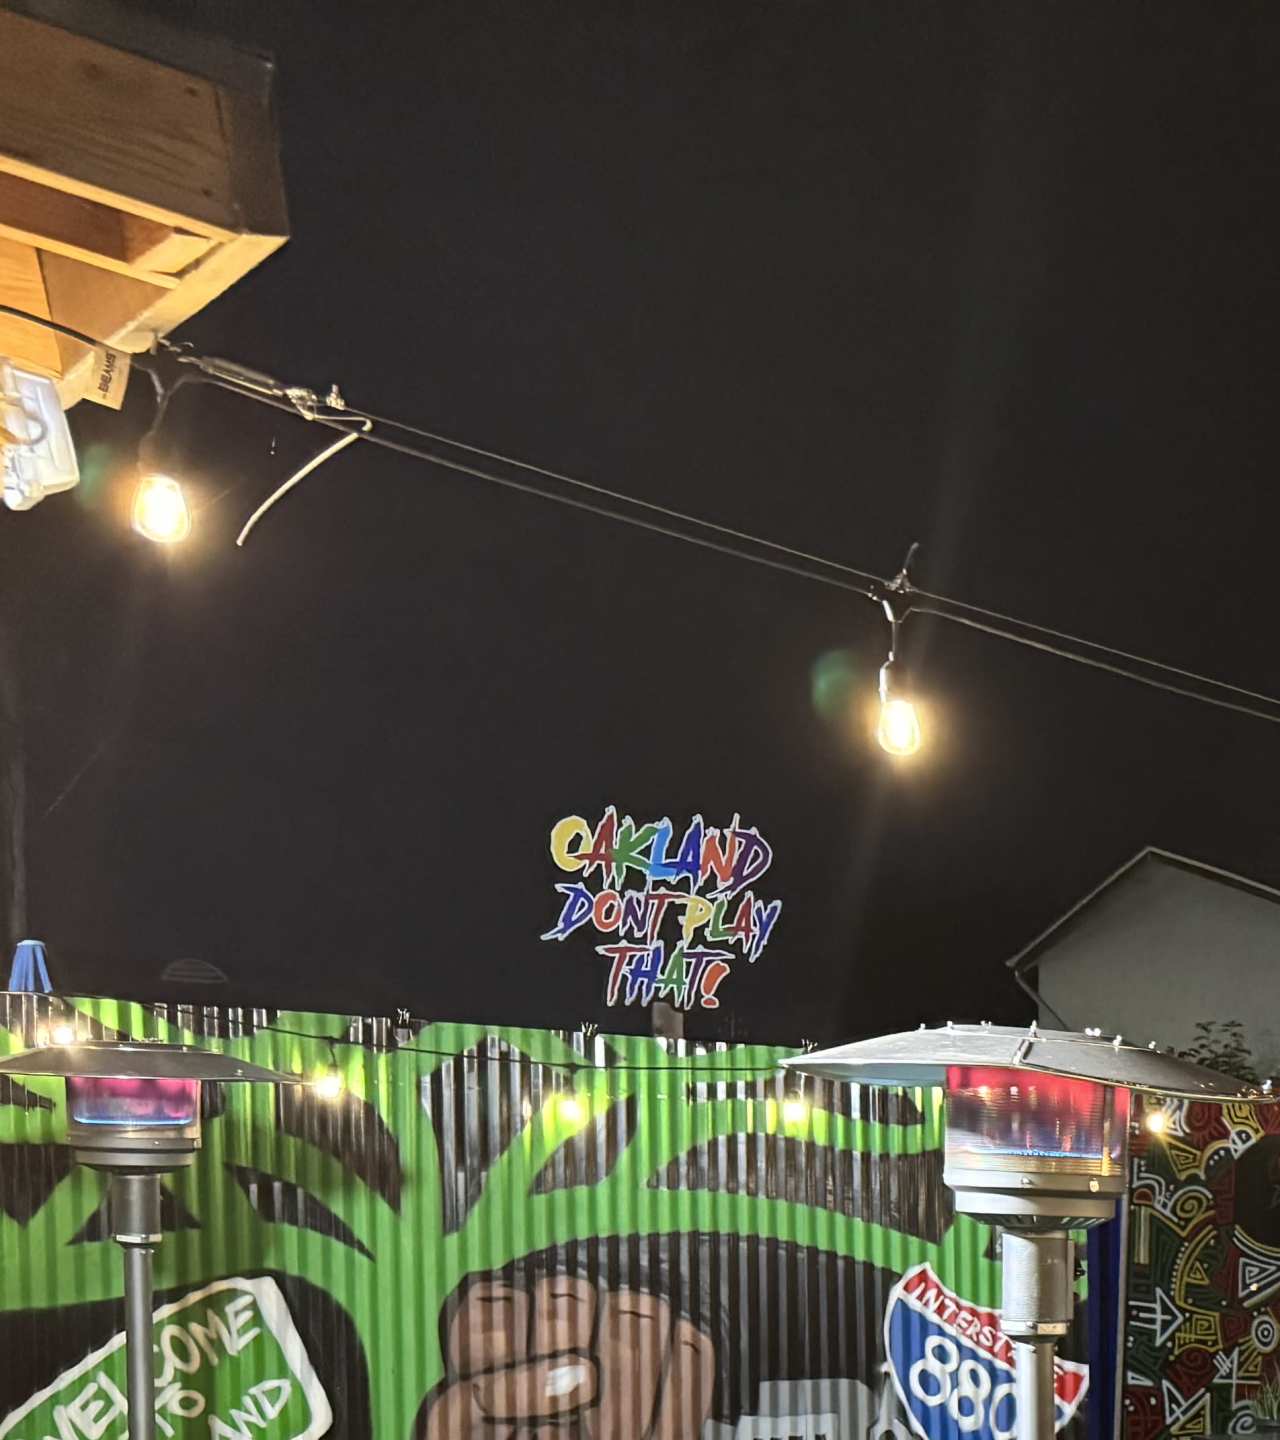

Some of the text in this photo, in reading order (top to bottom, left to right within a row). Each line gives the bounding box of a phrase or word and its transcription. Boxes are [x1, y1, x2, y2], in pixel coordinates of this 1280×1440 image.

[550, 805, 772, 898] OAKLAND
[540, 882, 783, 963] DONT PLAY
[595, 939, 736, 1009] THAT!
